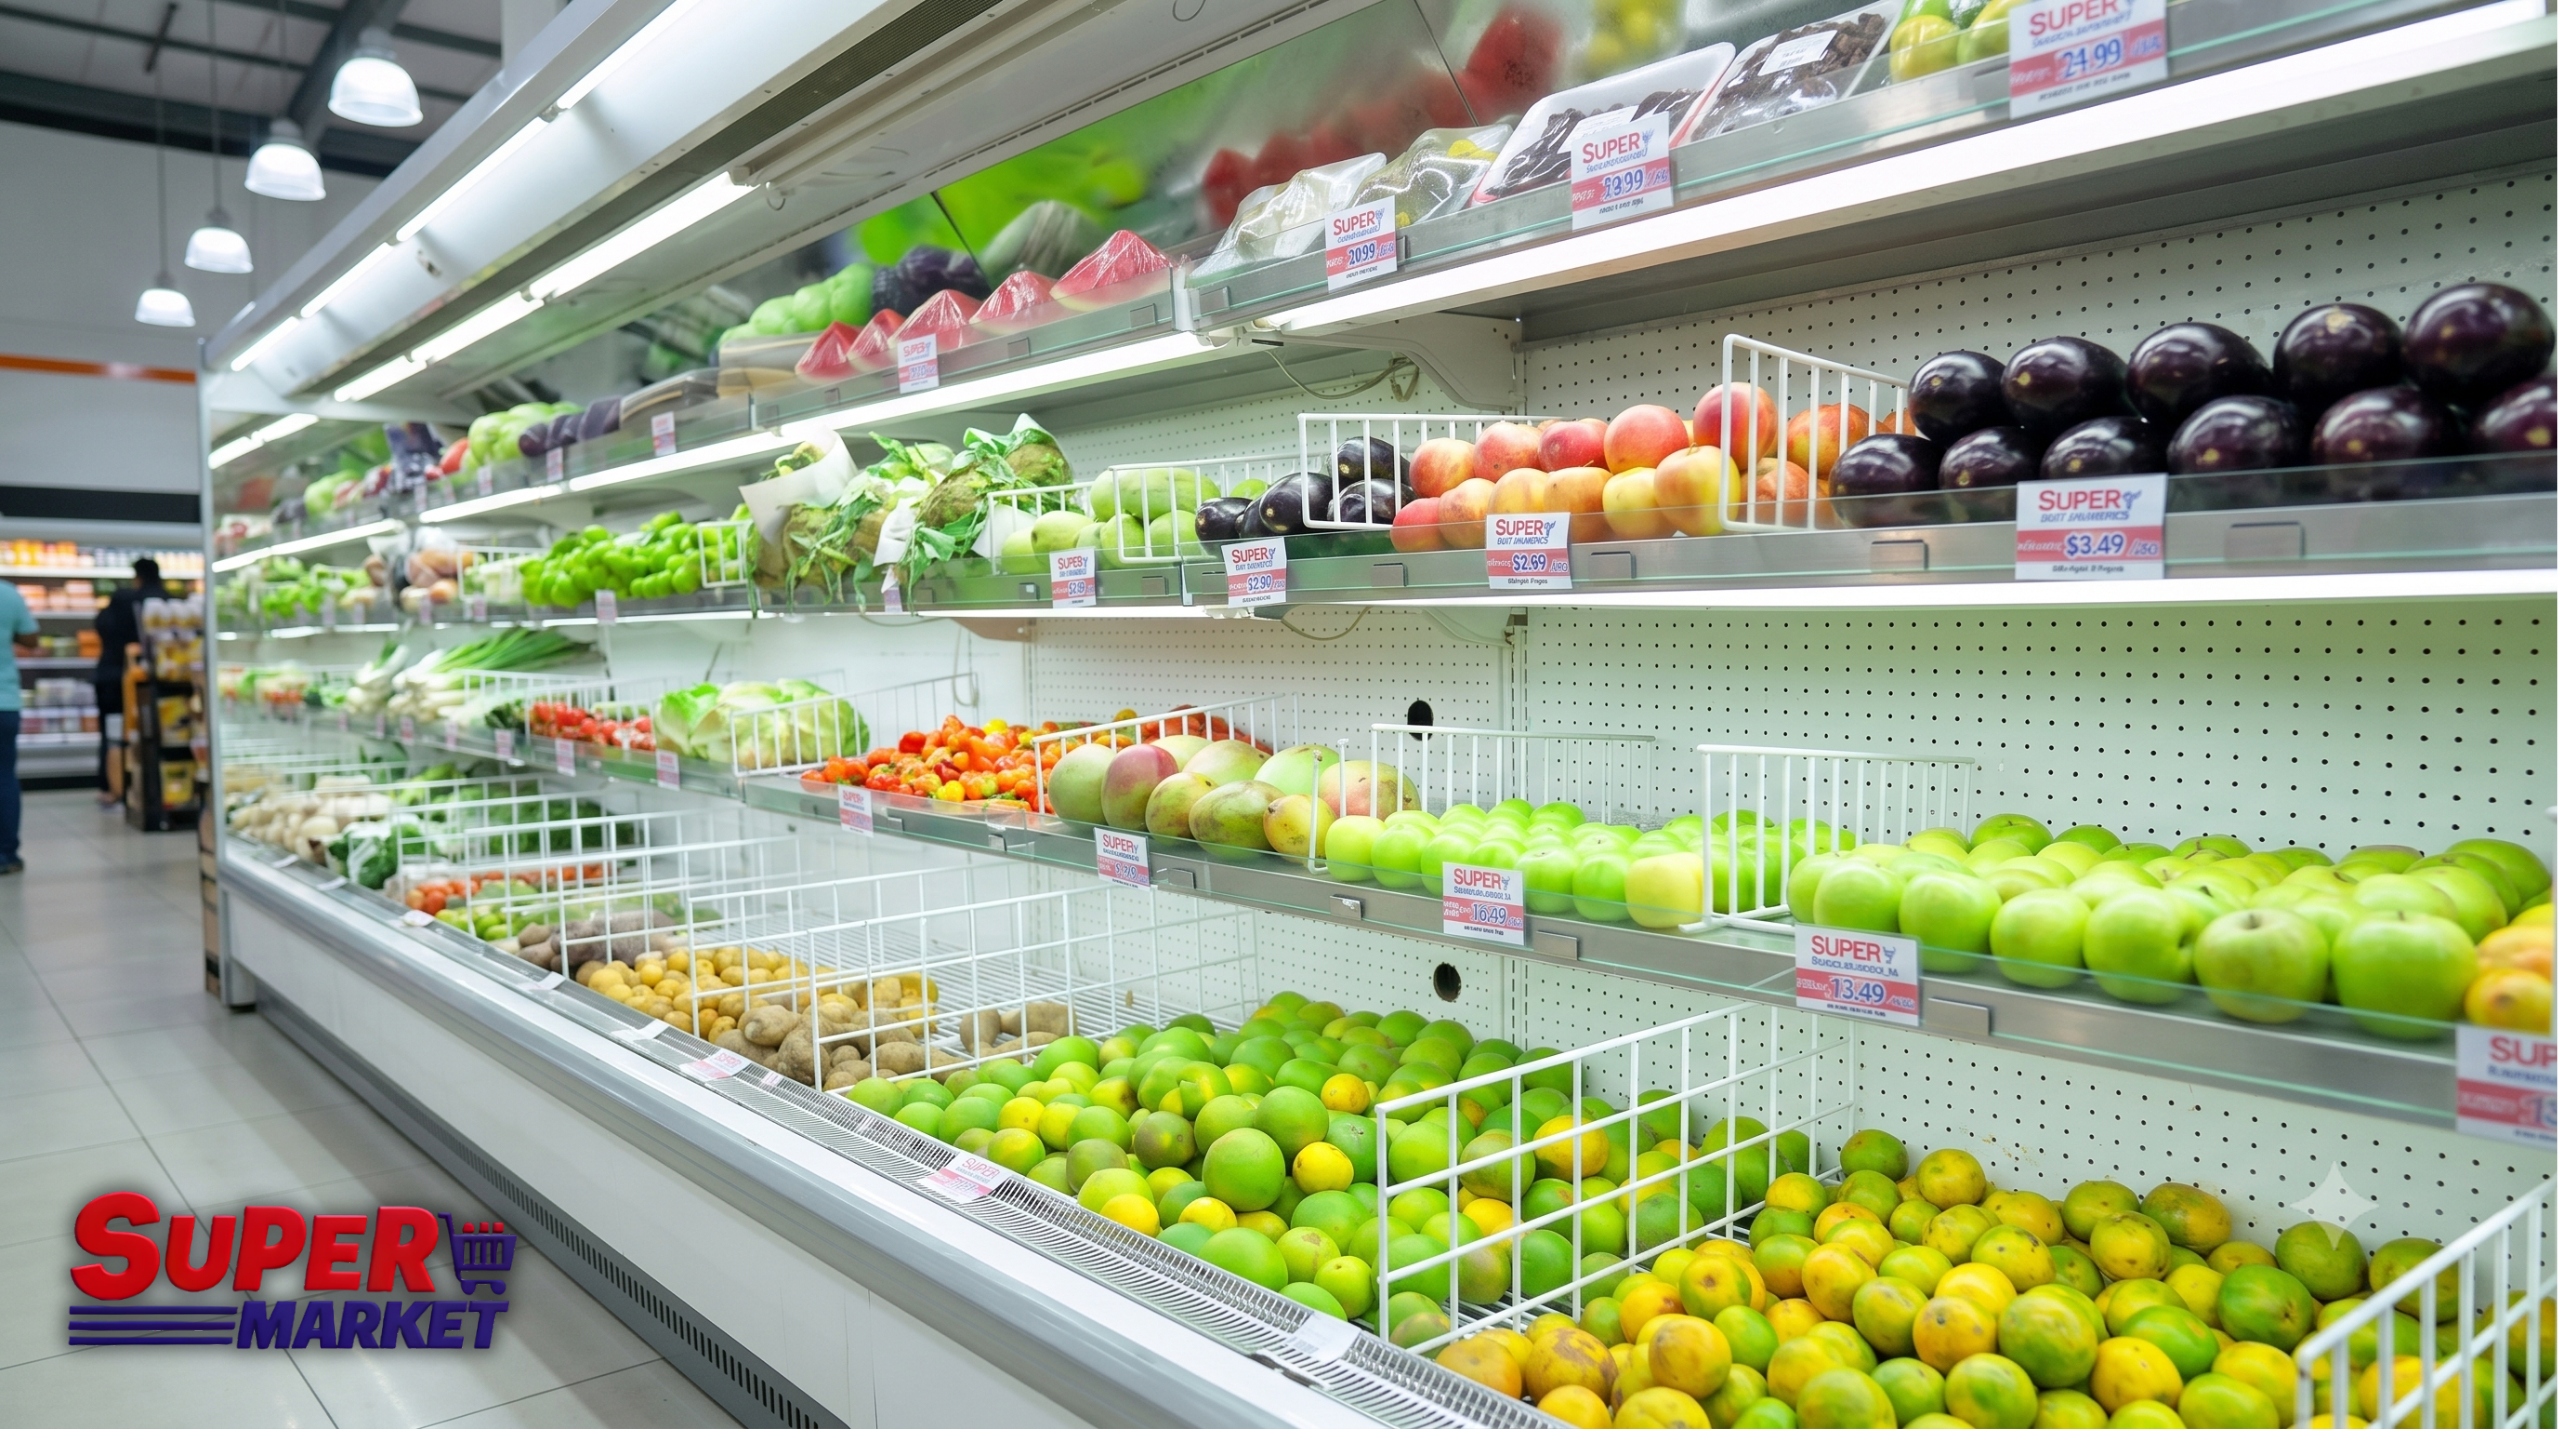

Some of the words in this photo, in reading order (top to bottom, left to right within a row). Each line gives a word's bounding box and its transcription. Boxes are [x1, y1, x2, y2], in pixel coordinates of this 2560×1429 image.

[2029, 0, 2119, 36] SUPER
[1582, 132, 1640, 164] SUPER
[1333, 210, 1375, 236] SUPER
[2038, 489, 2121, 511] SUPER
[1495, 518, 1543, 536] SUPER
[1231, 547, 1268, 564] SUPER
[2066, 534, 2124, 557] $3.49
[1102, 834, 1135, 854] SUPER
[1453, 868, 1501, 890] SUPER
[1811, 935, 1881, 963] SUPER
[1830, 977, 1885, 1003] 13.49
